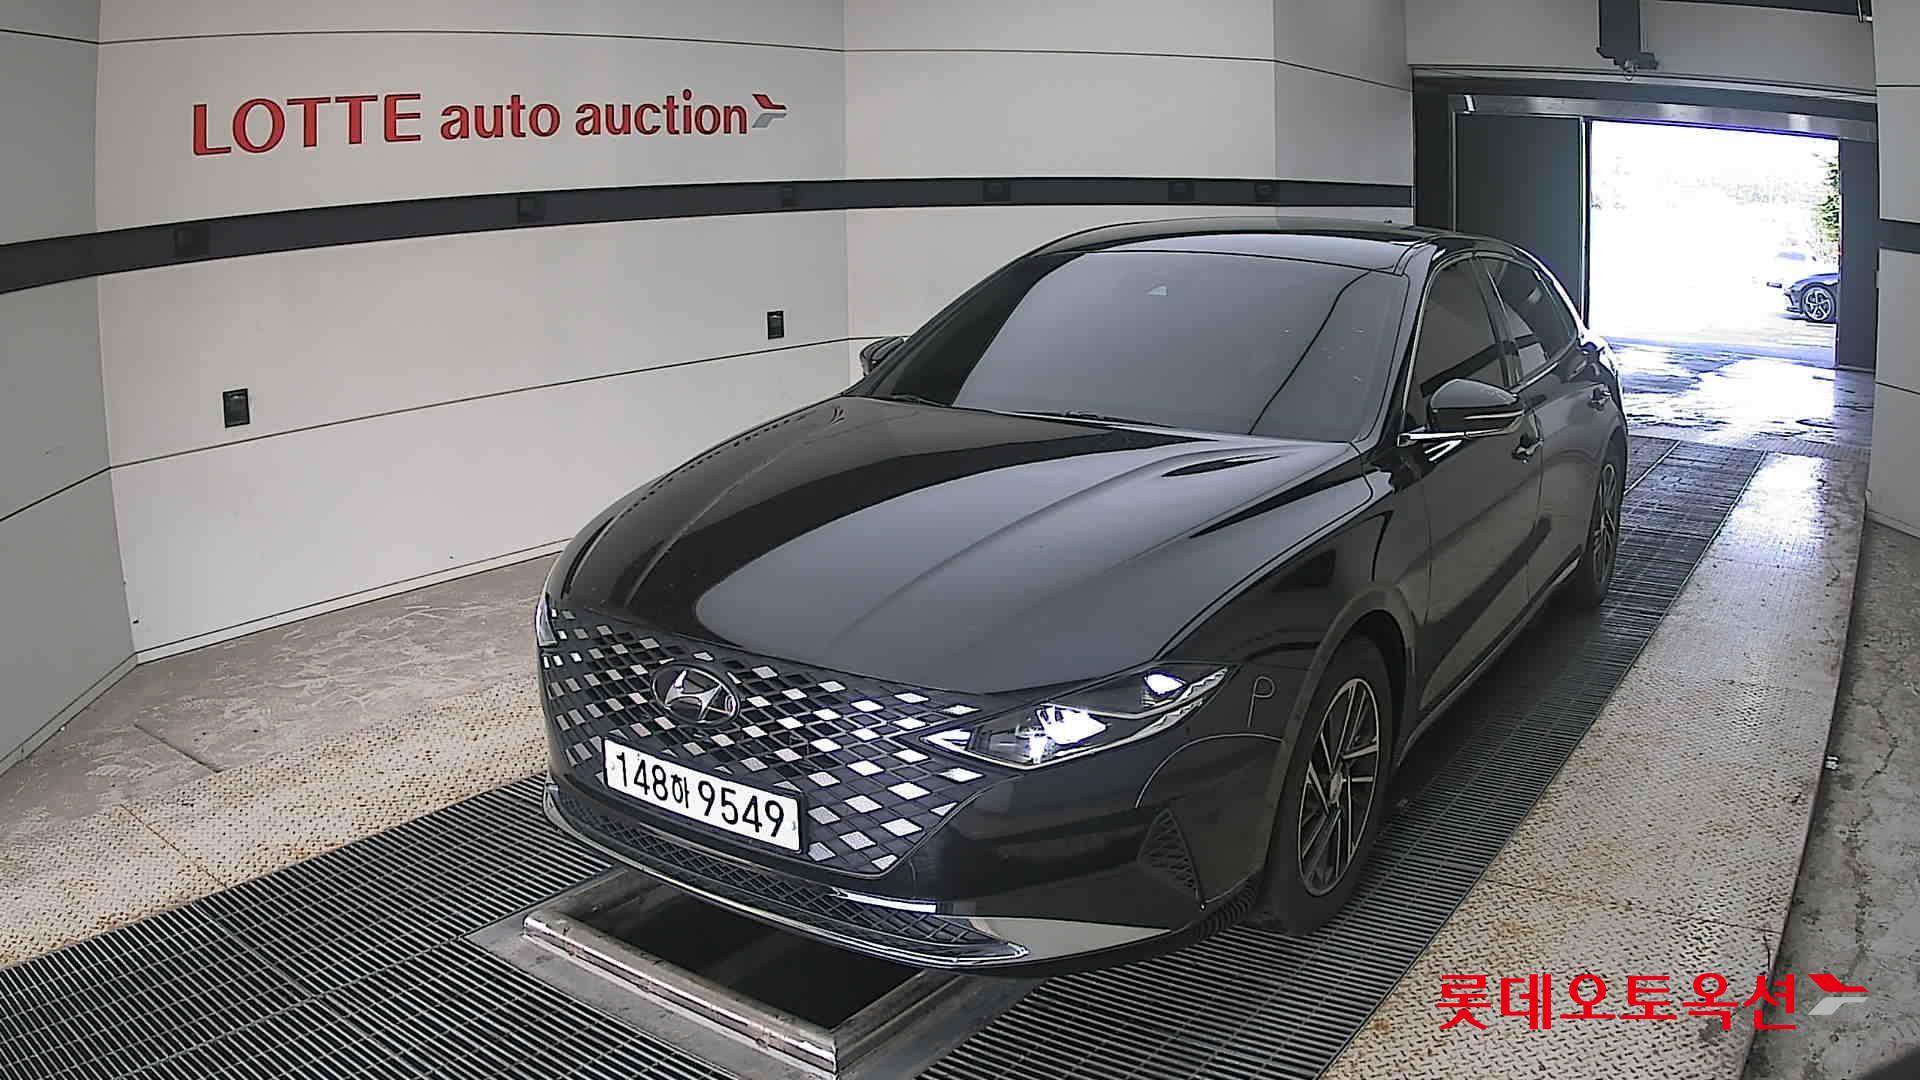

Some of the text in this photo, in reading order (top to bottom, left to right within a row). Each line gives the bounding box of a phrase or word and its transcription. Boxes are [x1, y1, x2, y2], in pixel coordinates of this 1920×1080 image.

[193, 88, 749, 156] LOTTE auto auction
[616, 752, 785, 838] 148하 9549
